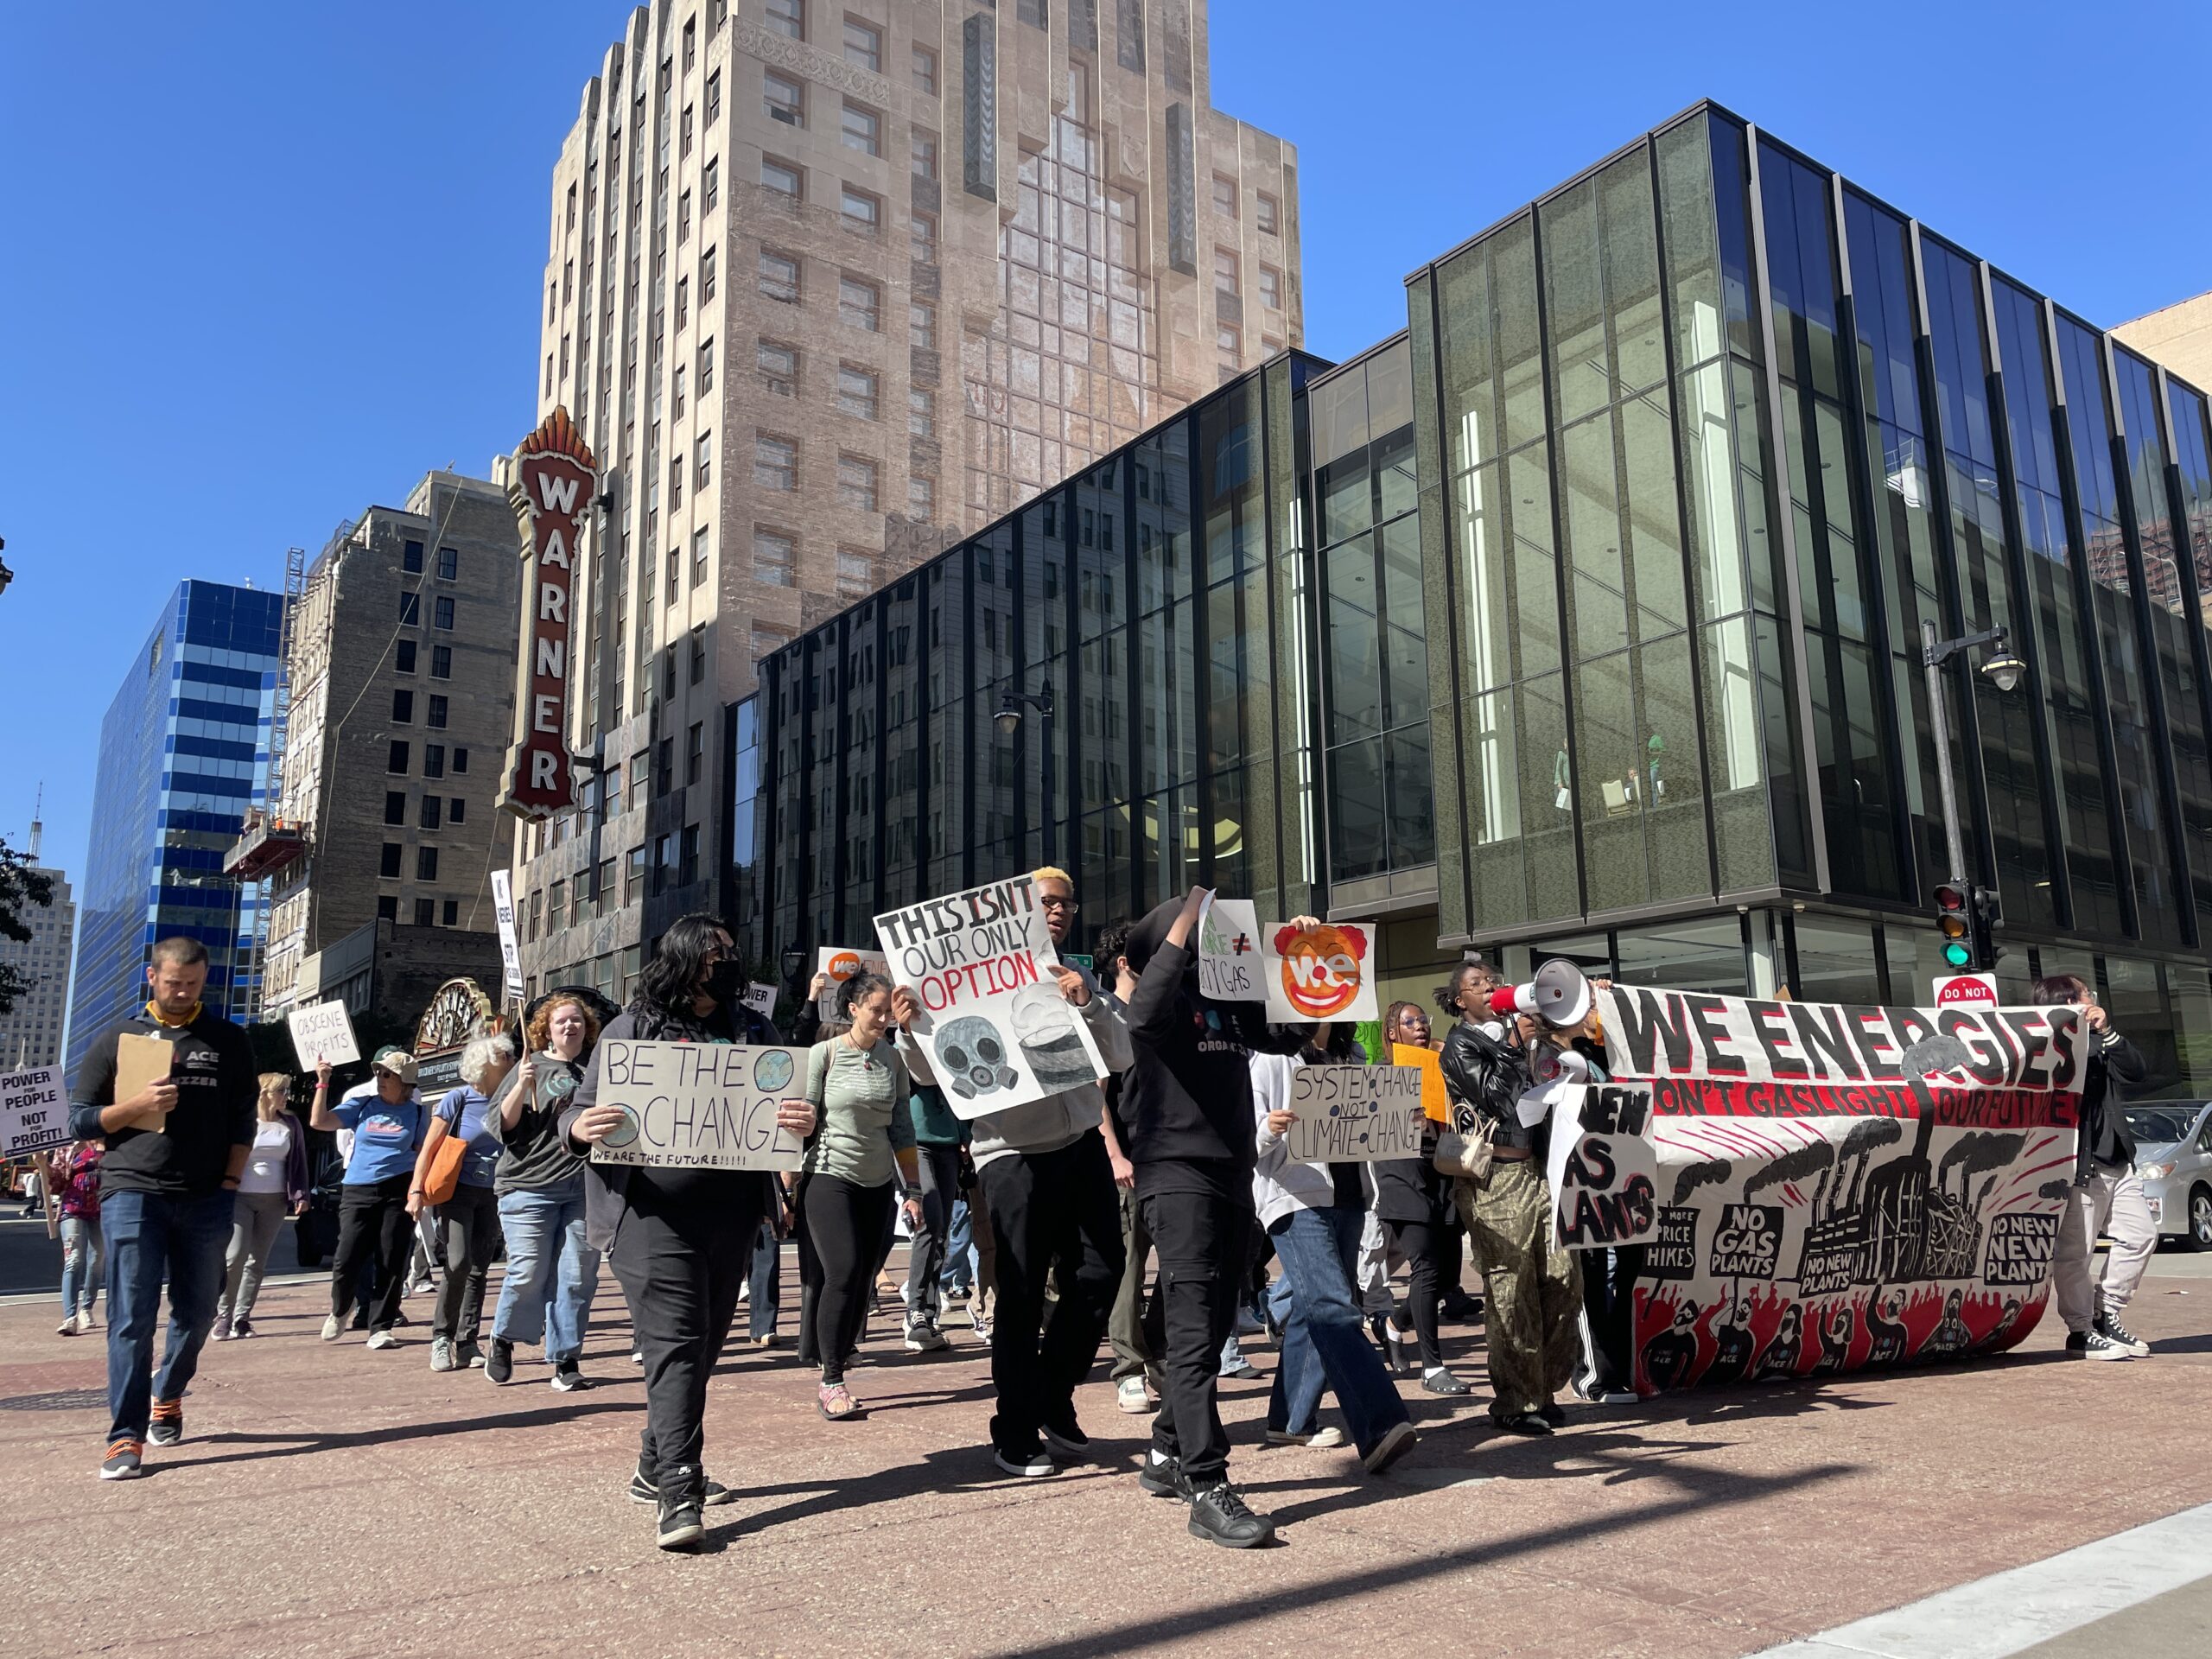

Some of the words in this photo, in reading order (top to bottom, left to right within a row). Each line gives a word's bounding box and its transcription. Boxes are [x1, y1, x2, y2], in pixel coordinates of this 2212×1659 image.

[531, 472, 580, 791] WARNER
[877, 897, 963, 950] THIS
[903, 934, 967, 977] OUR
[971, 917, 1032, 958] ONLY
[921, 950, 1039, 1011] OPTION
[1220, 961, 1250, 998] GAS
[1944, 988, 1960, 999] DO
[1965, 987, 1986, 998] NOT
[297, 1010, 343, 1036] OBSCENE
[425, 990, 471, 1038] WARNER
[1610, 987, 1748, 1077] WE
[187, 1051, 220, 1063] ACE
[304, 1033, 349, 1058] PROFITS
[608, 1043, 657, 1085] BE
[671, 1046, 747, 1087] THE
[2, 1071, 51, 1090] POWER
[1296, 1066, 1371, 1100] SYSTEM
[1375, 1066, 1421, 1097] CHANGE
[5, 1090, 57, 1109] PEOPLE
[1339, 1100, 1368, 1117] NOT
[1654, 1077, 1736, 1116] ON'T
[1745, 1082, 1911, 1118] GASLIGHT
[1939, 1087, 1986, 1125] OUR
[21, 1111, 48, 1126] NOT
[644, 1096, 803, 1154] CHANGE
[11, 1127, 63, 1147] PROFIT!
[1288, 1118, 1360, 1160] CLIMATE
[1367, 1109, 1421, 1153] CHANGE
[593, 1151, 610, 1160] WE
[612, 1152, 635, 1162] ARE
[639, 1153, 662, 1164] THE
[666, 1154, 747, 1166] FUTURE!!!!!
[1562, 1138, 1617, 1190] AS
[1557, 1173, 1656, 1247] LANTS
[1669, 1211, 1694, 1222] MORE
[1730, 1206, 1766, 1230] NO
[1657, 1225, 1691, 1243] PRICE
[1991, 1217, 2008, 1236] NO
[2011, 1216, 2056, 1236] NEW
[1715, 1228, 1777, 1257] GAS
[1988, 1236, 2056, 1261] NEW
[1647, 1247, 1694, 1268] HIKES
[1711, 1254, 1775, 1275] PLANTS
[1806, 1256, 1825, 1275] NO
[1826, 1252, 1853, 1273] NEW
[1801, 1270, 1850, 1294] PLANTS
[1987, 1261, 2046, 1281] PLANT
[1719, 1355, 1738, 1363] ACE
